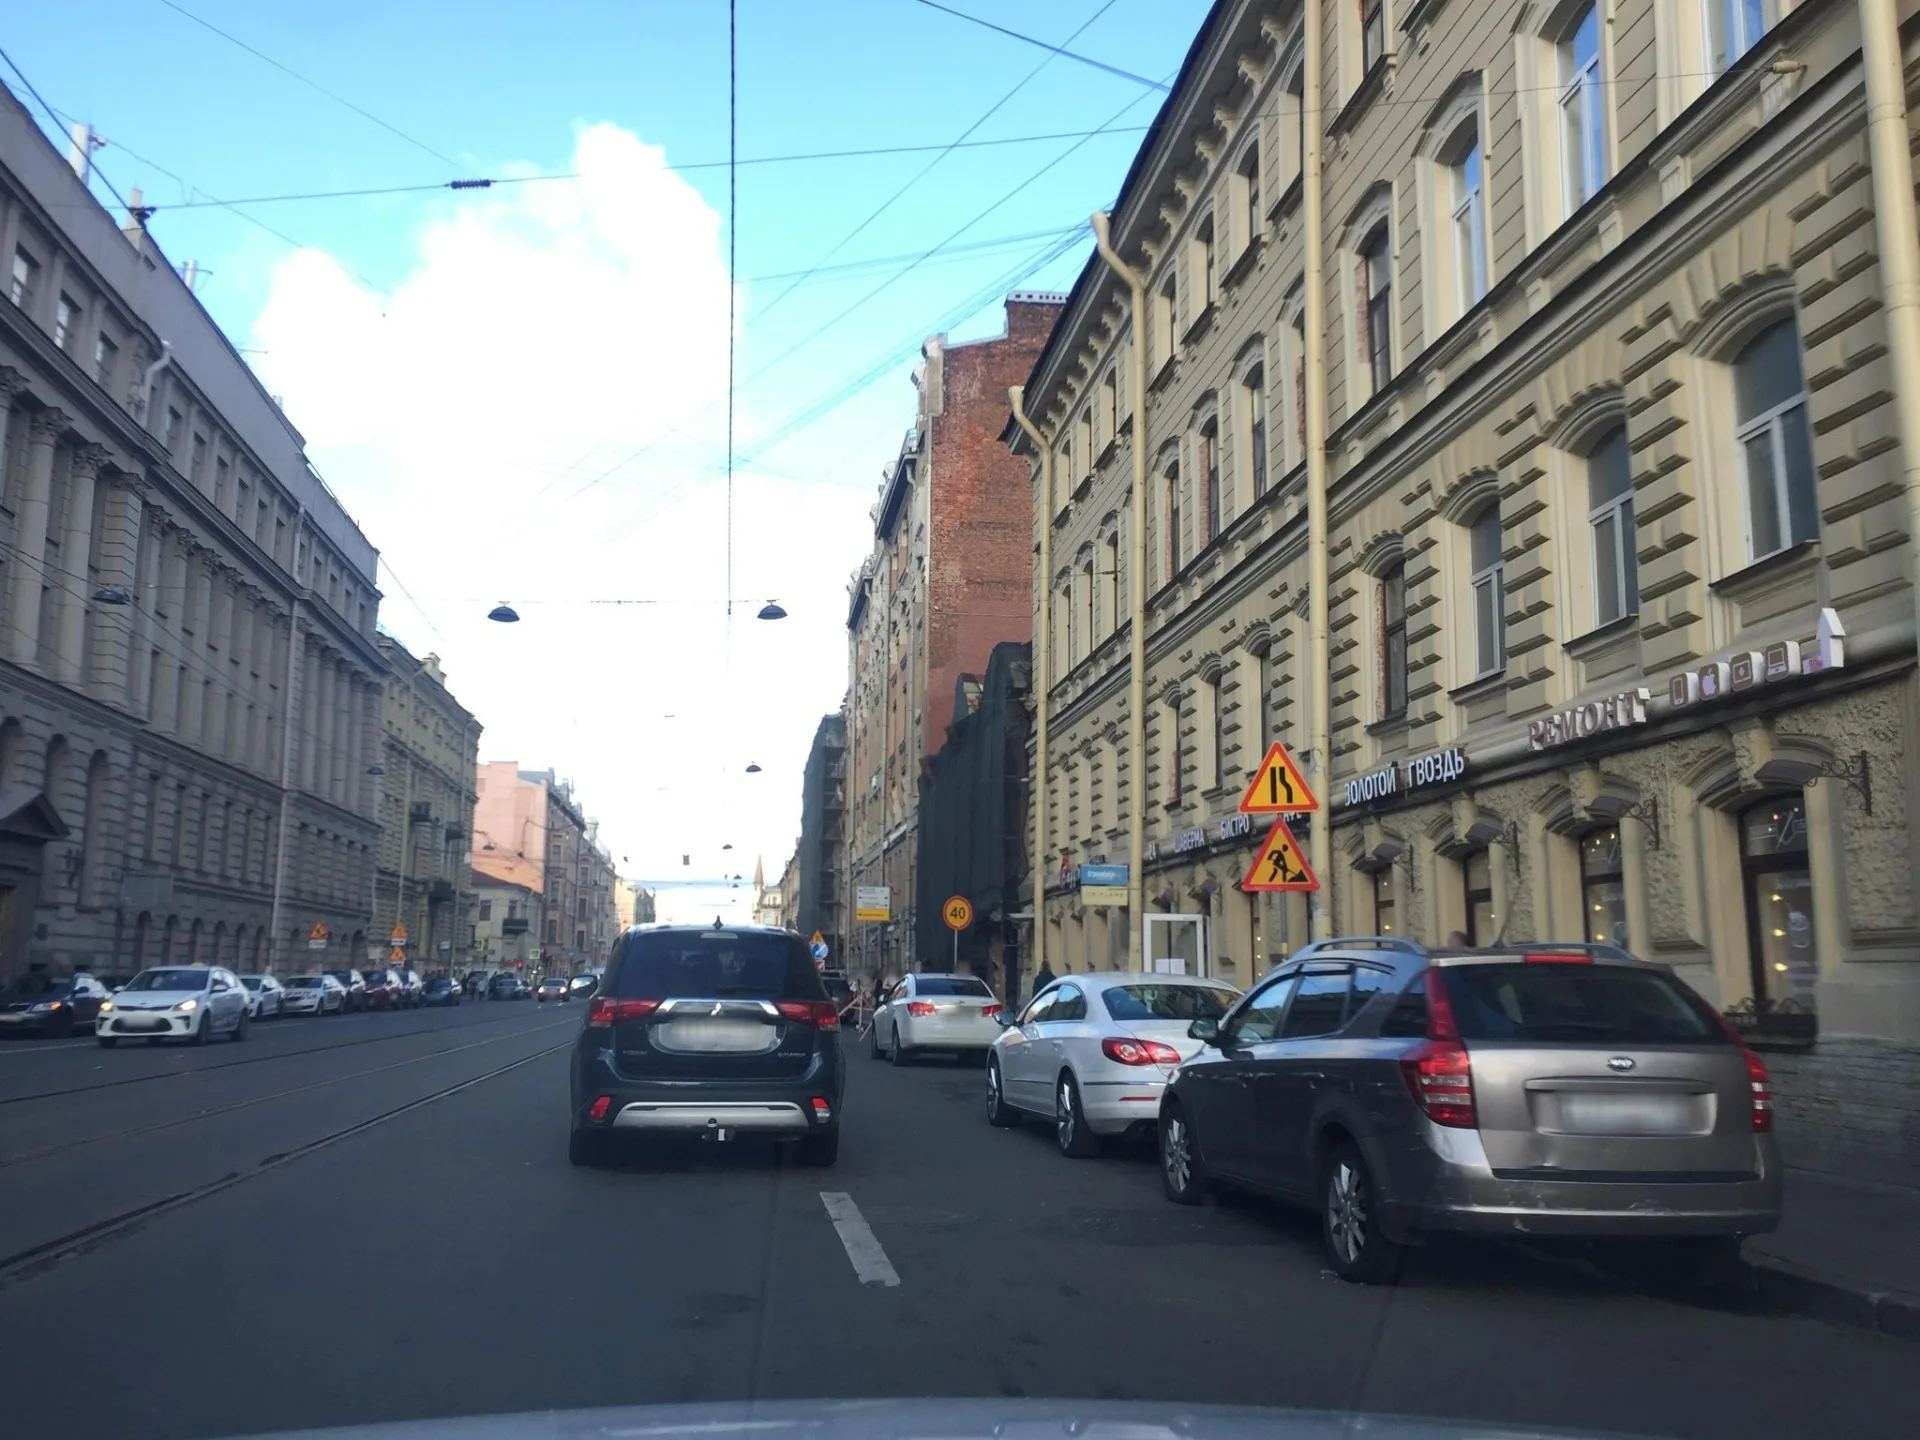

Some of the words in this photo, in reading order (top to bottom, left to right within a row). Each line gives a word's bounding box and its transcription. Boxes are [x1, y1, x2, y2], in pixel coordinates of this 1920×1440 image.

[1527, 688, 1649, 750] РЕМОНТ
[1344, 762, 1397, 807] ЗОЛОТОЙ
[1408, 748, 1465, 788] ГВОЗДЬ
[1174, 828, 1205, 853] ШАВЕРМА
[1220, 814, 1250, 840] БИСТРО
[950, 907, 966, 919] 40
